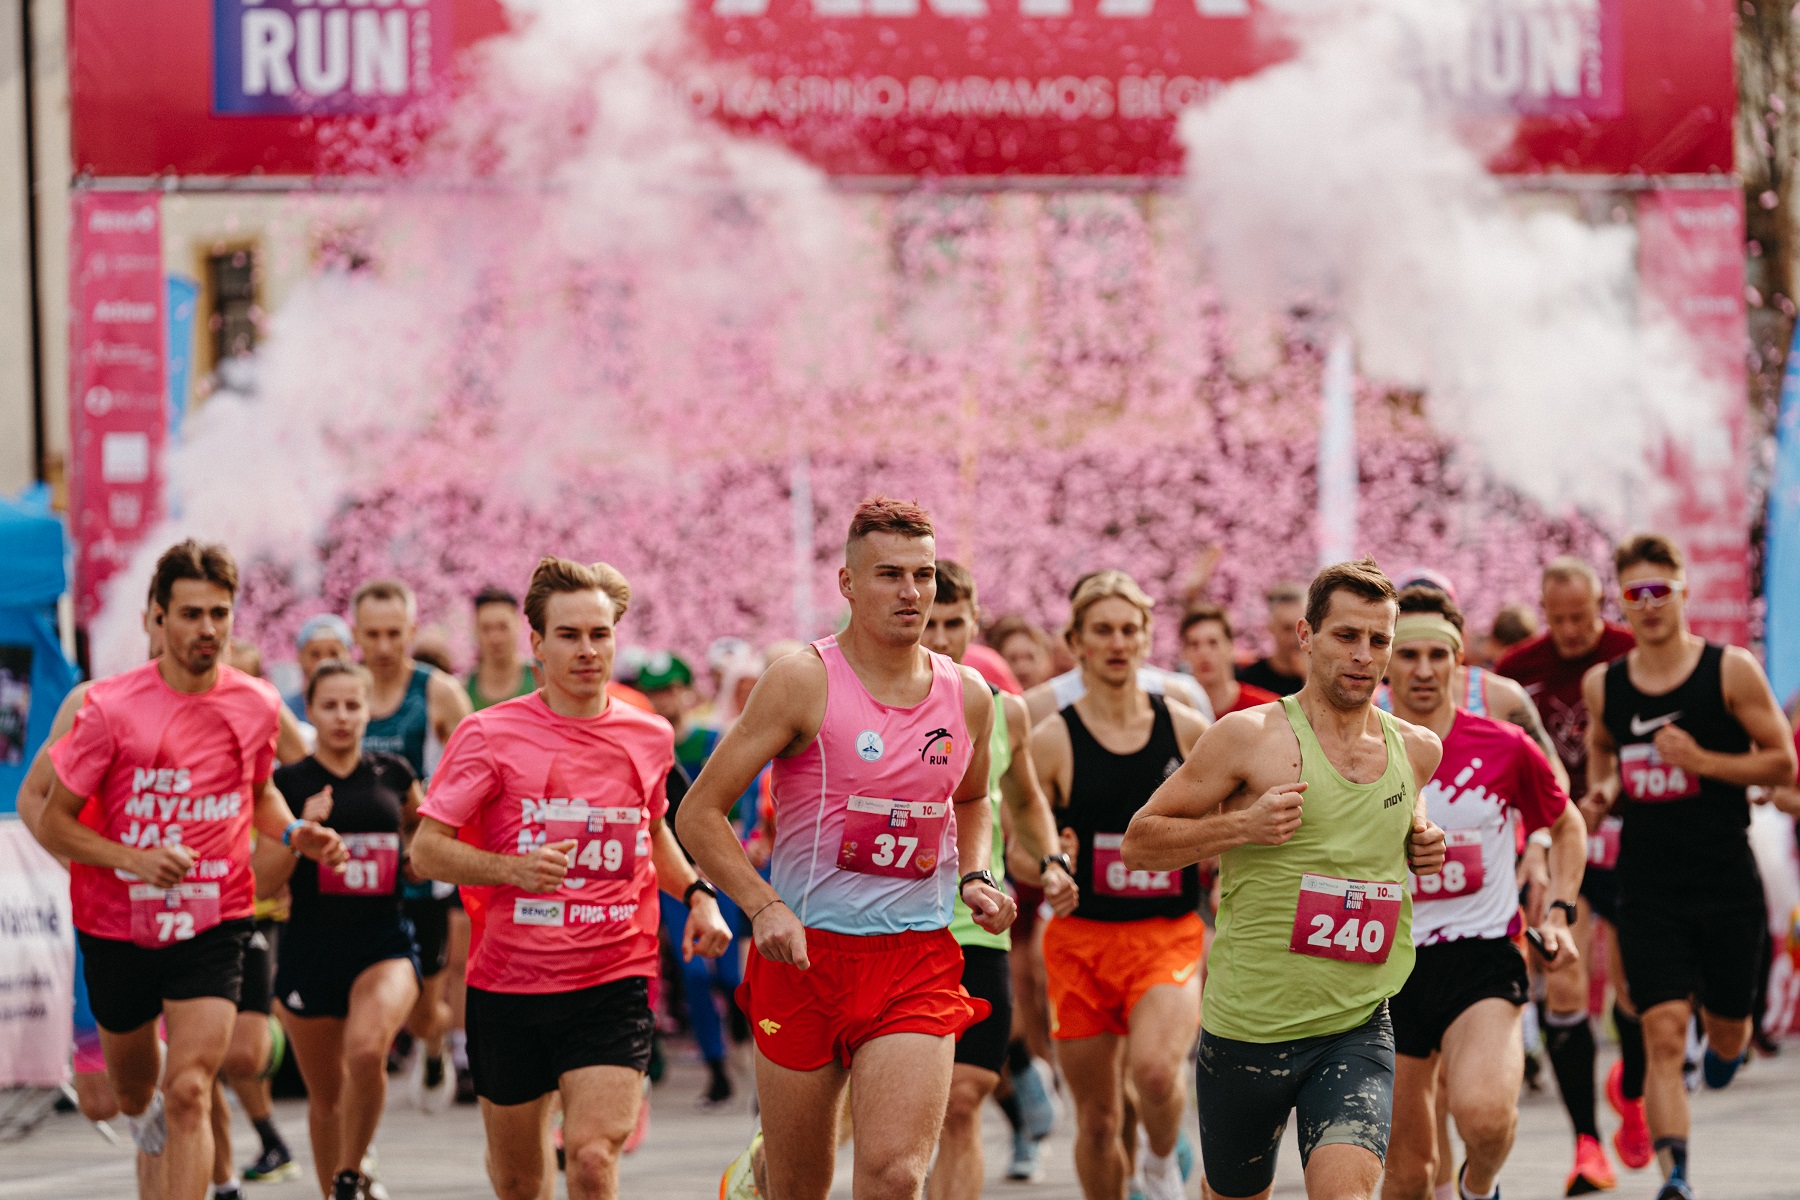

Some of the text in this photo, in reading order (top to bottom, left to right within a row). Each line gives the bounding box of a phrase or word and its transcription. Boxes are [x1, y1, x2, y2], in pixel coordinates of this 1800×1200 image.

[241, 7, 409, 97] RUN
[937, 741, 952, 754] PB
[930, 755, 948, 765] RUN
[1631, 766, 1688, 798] 704
[892, 809, 910, 820] PINK
[923, 805, 932, 815] 10
[890, 818, 907, 828] RUN
[561, 838, 624, 872] 149
[871, 833, 918, 869] 37
[1347, 891, 1364, 901] PINK
[1377, 887, 1388, 897] 10
[1346, 899, 1362, 910] RUN
[521, 906, 549, 918] BENU
[569, 903, 606, 923] PINK
[155, 911, 196, 942] 72
[1307, 913, 1385, 953] 240
